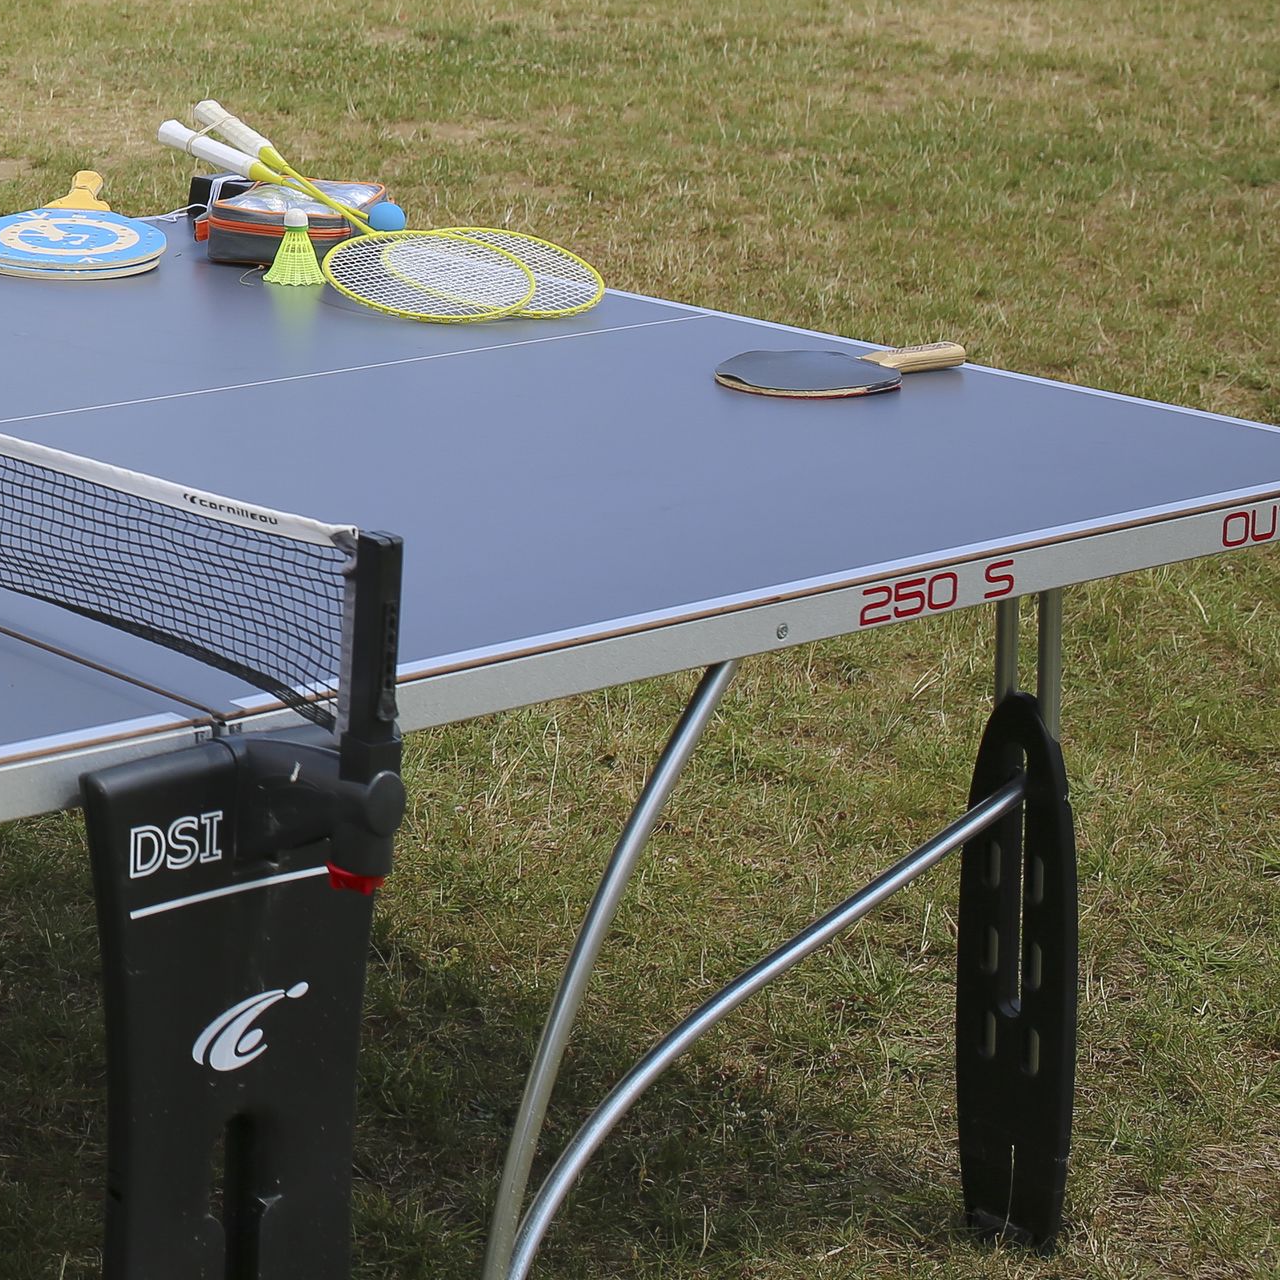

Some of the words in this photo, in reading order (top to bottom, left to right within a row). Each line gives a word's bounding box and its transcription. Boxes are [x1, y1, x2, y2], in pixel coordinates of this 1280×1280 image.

[198, 498, 279, 526] cornilleau
[1222, 504, 1280, 548] OU
[859, 571, 958, 627] 250
[983, 559, 1014, 599] S
[129, 810, 224, 880] DSI
